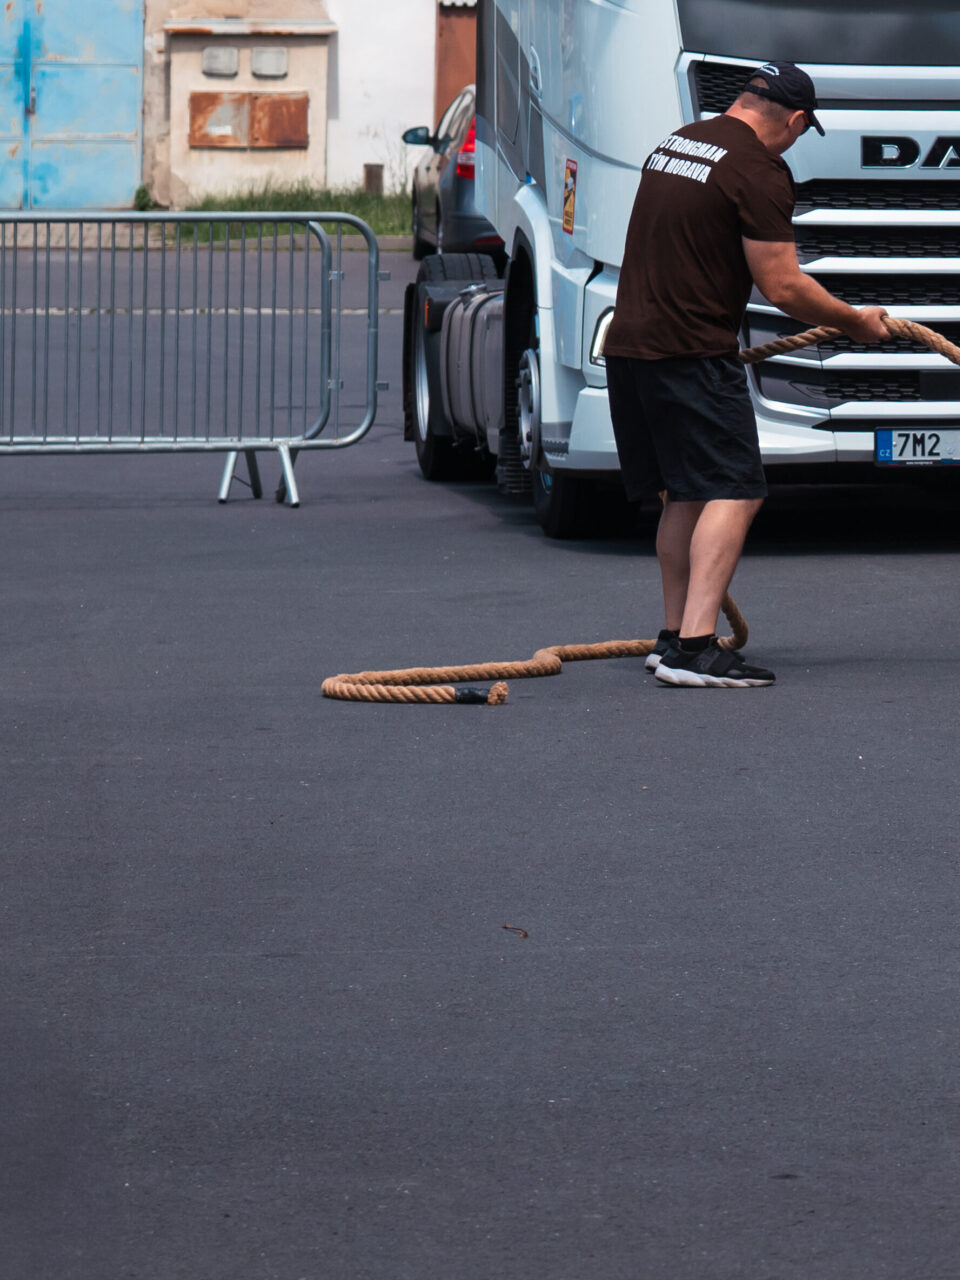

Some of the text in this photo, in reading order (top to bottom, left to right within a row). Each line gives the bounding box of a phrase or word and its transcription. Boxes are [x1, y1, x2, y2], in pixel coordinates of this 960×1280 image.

[660, 134, 728, 163] STRONGMAN
[647, 151, 712, 183] TÝM MORAVA
[897, 433, 941, 457] 7M2
